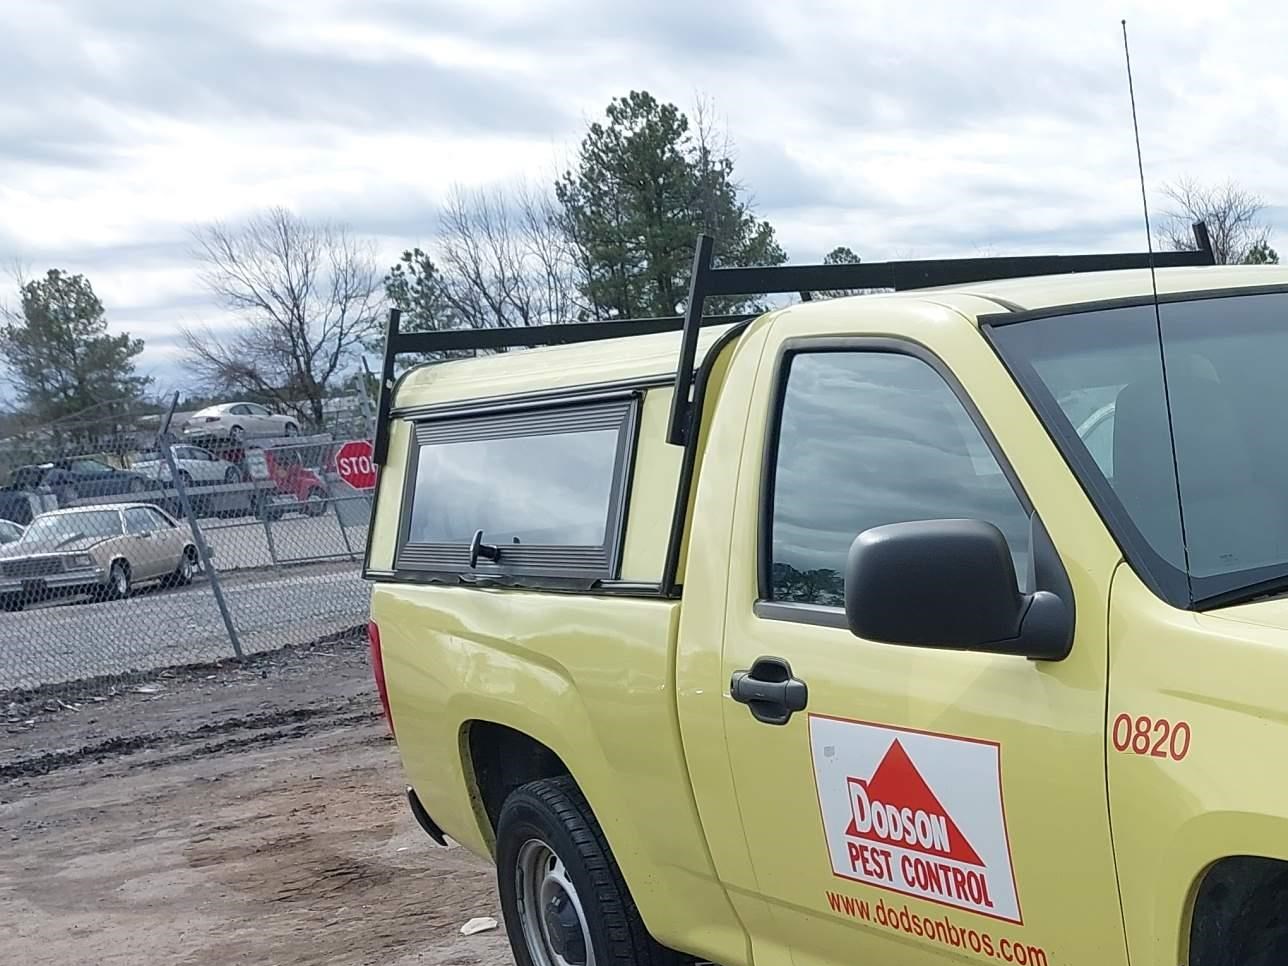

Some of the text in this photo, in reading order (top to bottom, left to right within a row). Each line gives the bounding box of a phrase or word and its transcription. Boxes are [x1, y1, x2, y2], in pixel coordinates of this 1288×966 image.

[1112, 713, 1191, 761] 0820
[847, 841, 994, 908] PEST CONTROL
